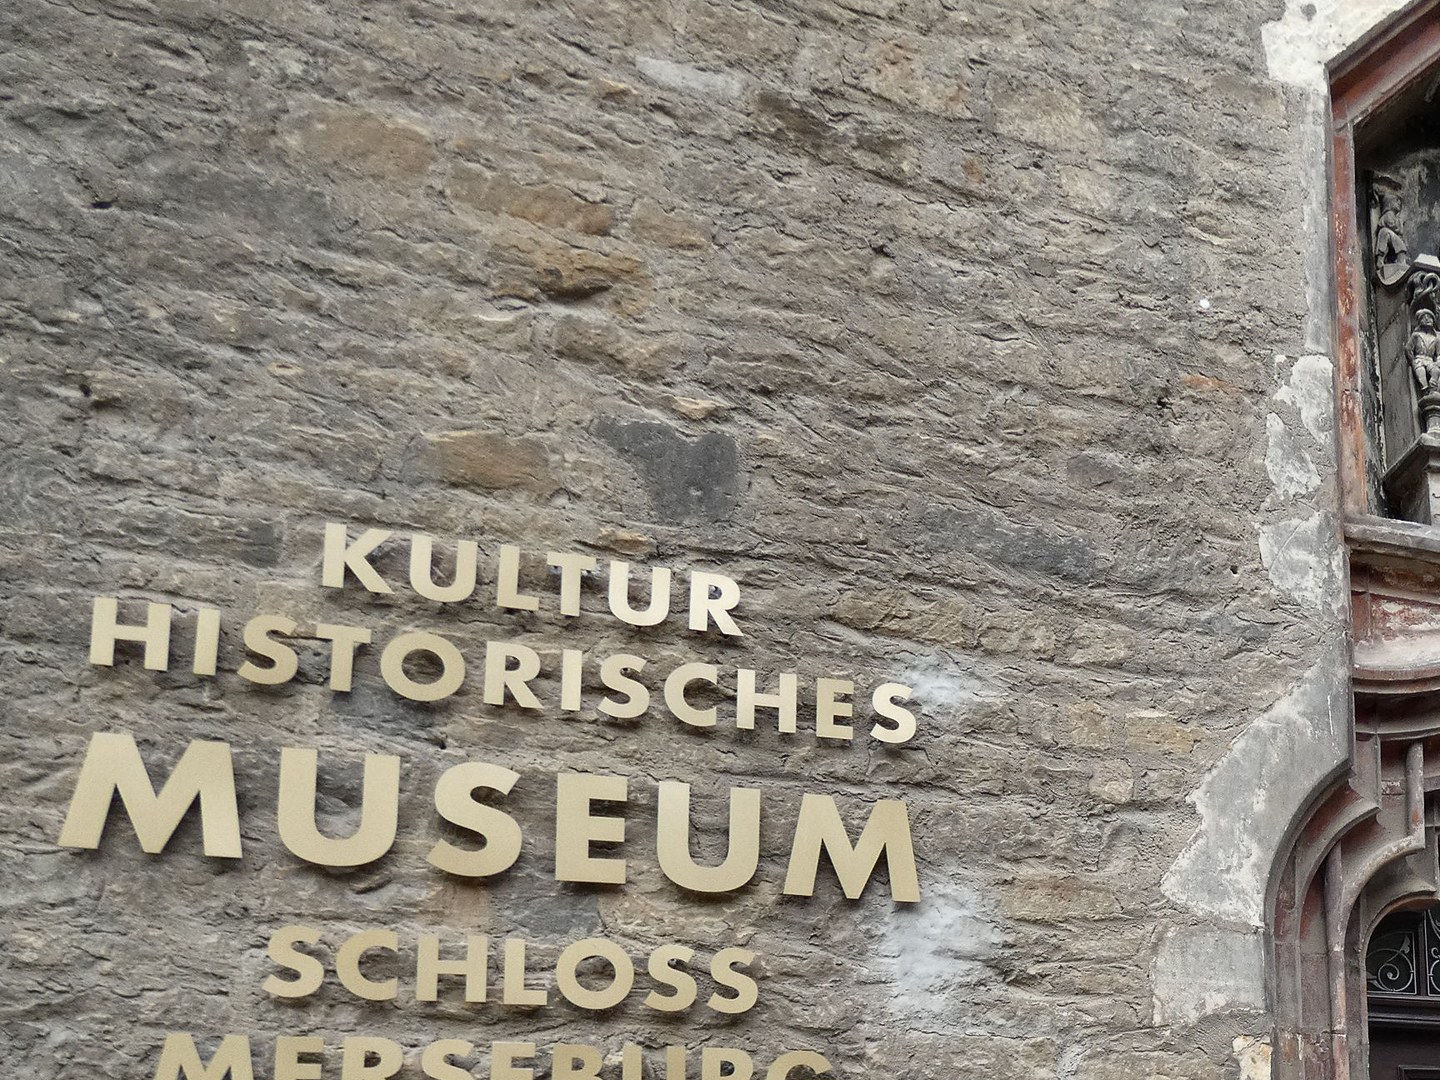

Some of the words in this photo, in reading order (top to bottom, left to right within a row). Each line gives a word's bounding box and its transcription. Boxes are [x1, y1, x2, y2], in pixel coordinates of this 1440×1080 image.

[322, 522, 743, 637] KULTUR
[89, 597, 917, 744] HISTORISCHES
[57, 731, 922, 903] MUSEUM
[261, 924, 760, 1015] SCHLOSS
